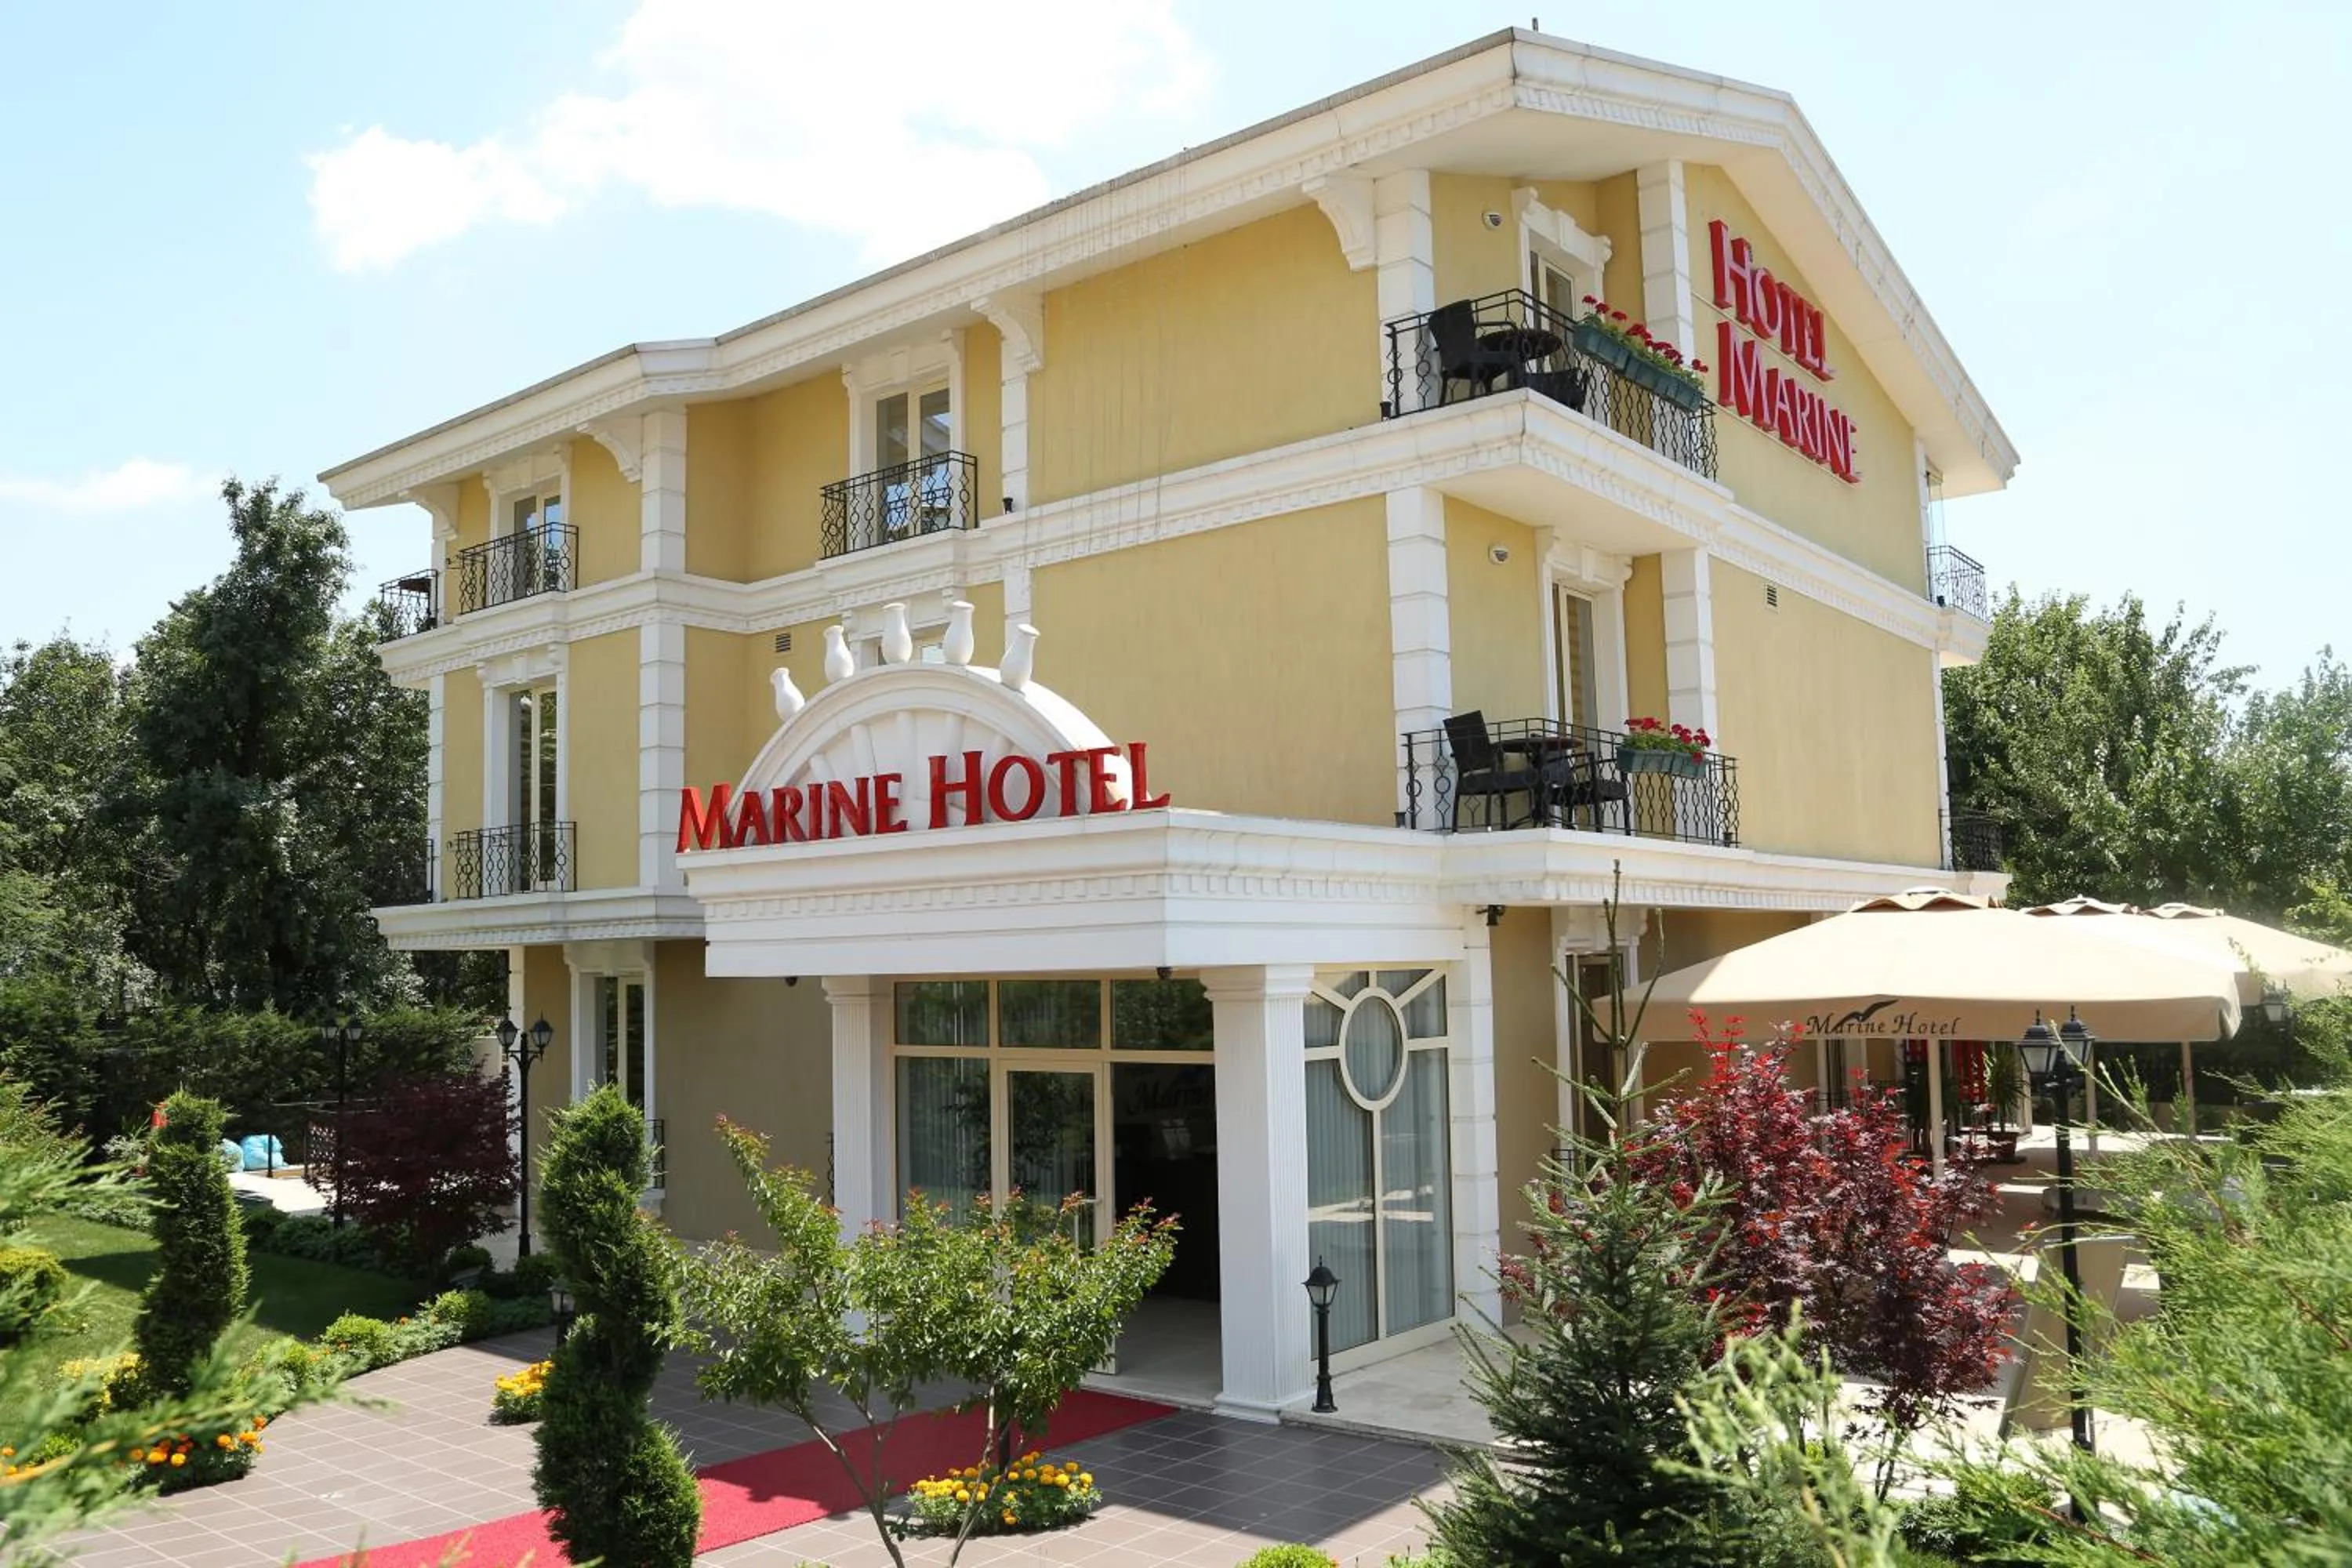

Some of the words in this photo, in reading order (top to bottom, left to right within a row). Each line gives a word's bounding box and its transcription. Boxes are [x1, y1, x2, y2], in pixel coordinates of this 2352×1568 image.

[1708, 220, 1835, 382] HOTEL
[1717, 321, 1861, 484] MARINE
[676, 772, 908, 853] MARINE
[928, 742, 1171, 829] HOTEL
[1806, 1012, 1886, 1035] Marine
[1891, 1011, 1962, 1035] Hotel
